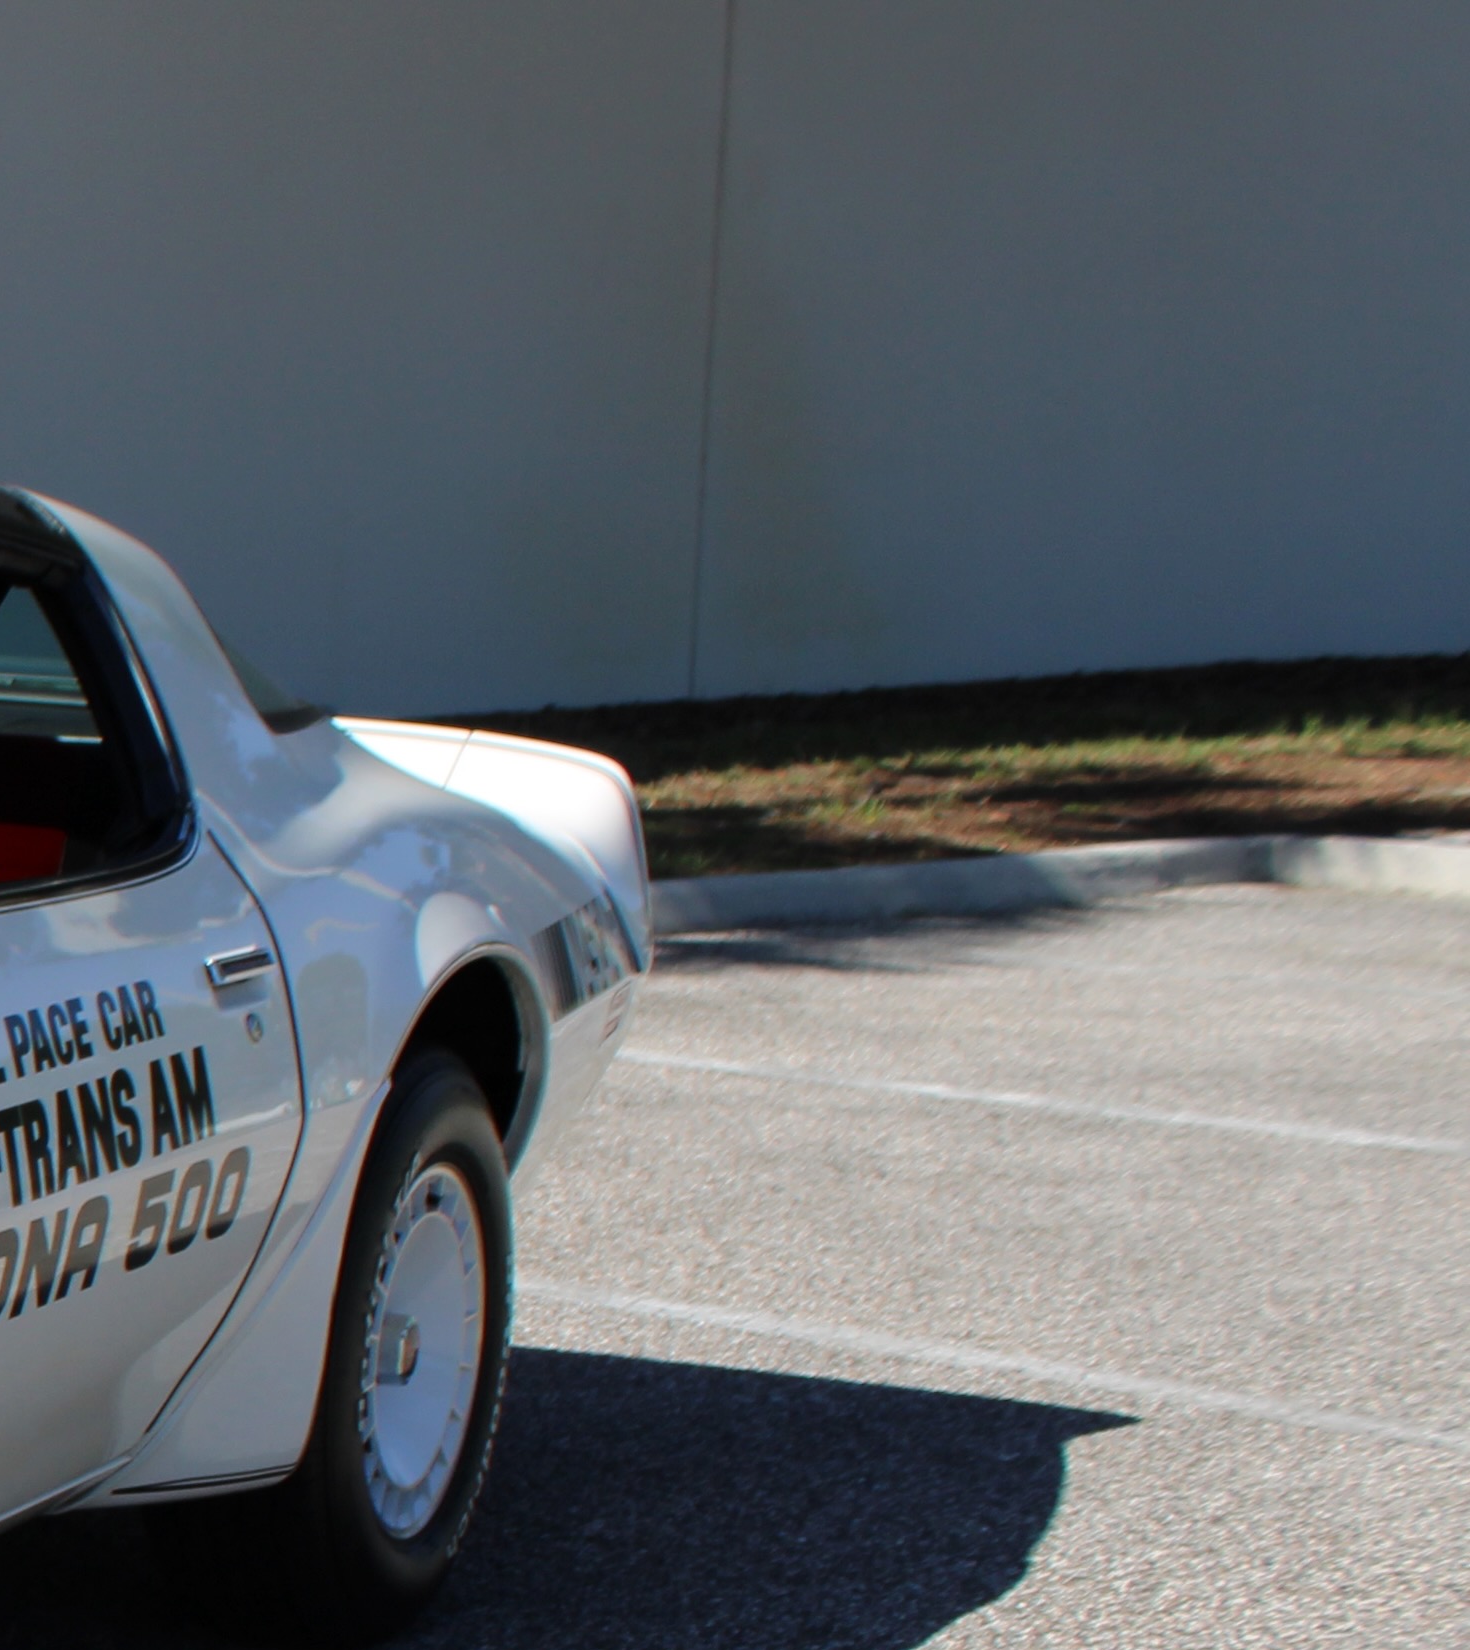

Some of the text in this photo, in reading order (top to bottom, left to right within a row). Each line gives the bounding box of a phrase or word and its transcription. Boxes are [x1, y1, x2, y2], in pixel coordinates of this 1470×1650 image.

[4, 998, 92, 1079] PACE
[97, 980, 165, 1051] CAR
[152, 1046, 216, 1156] AM
[125, 1147, 251, 1272] 500
